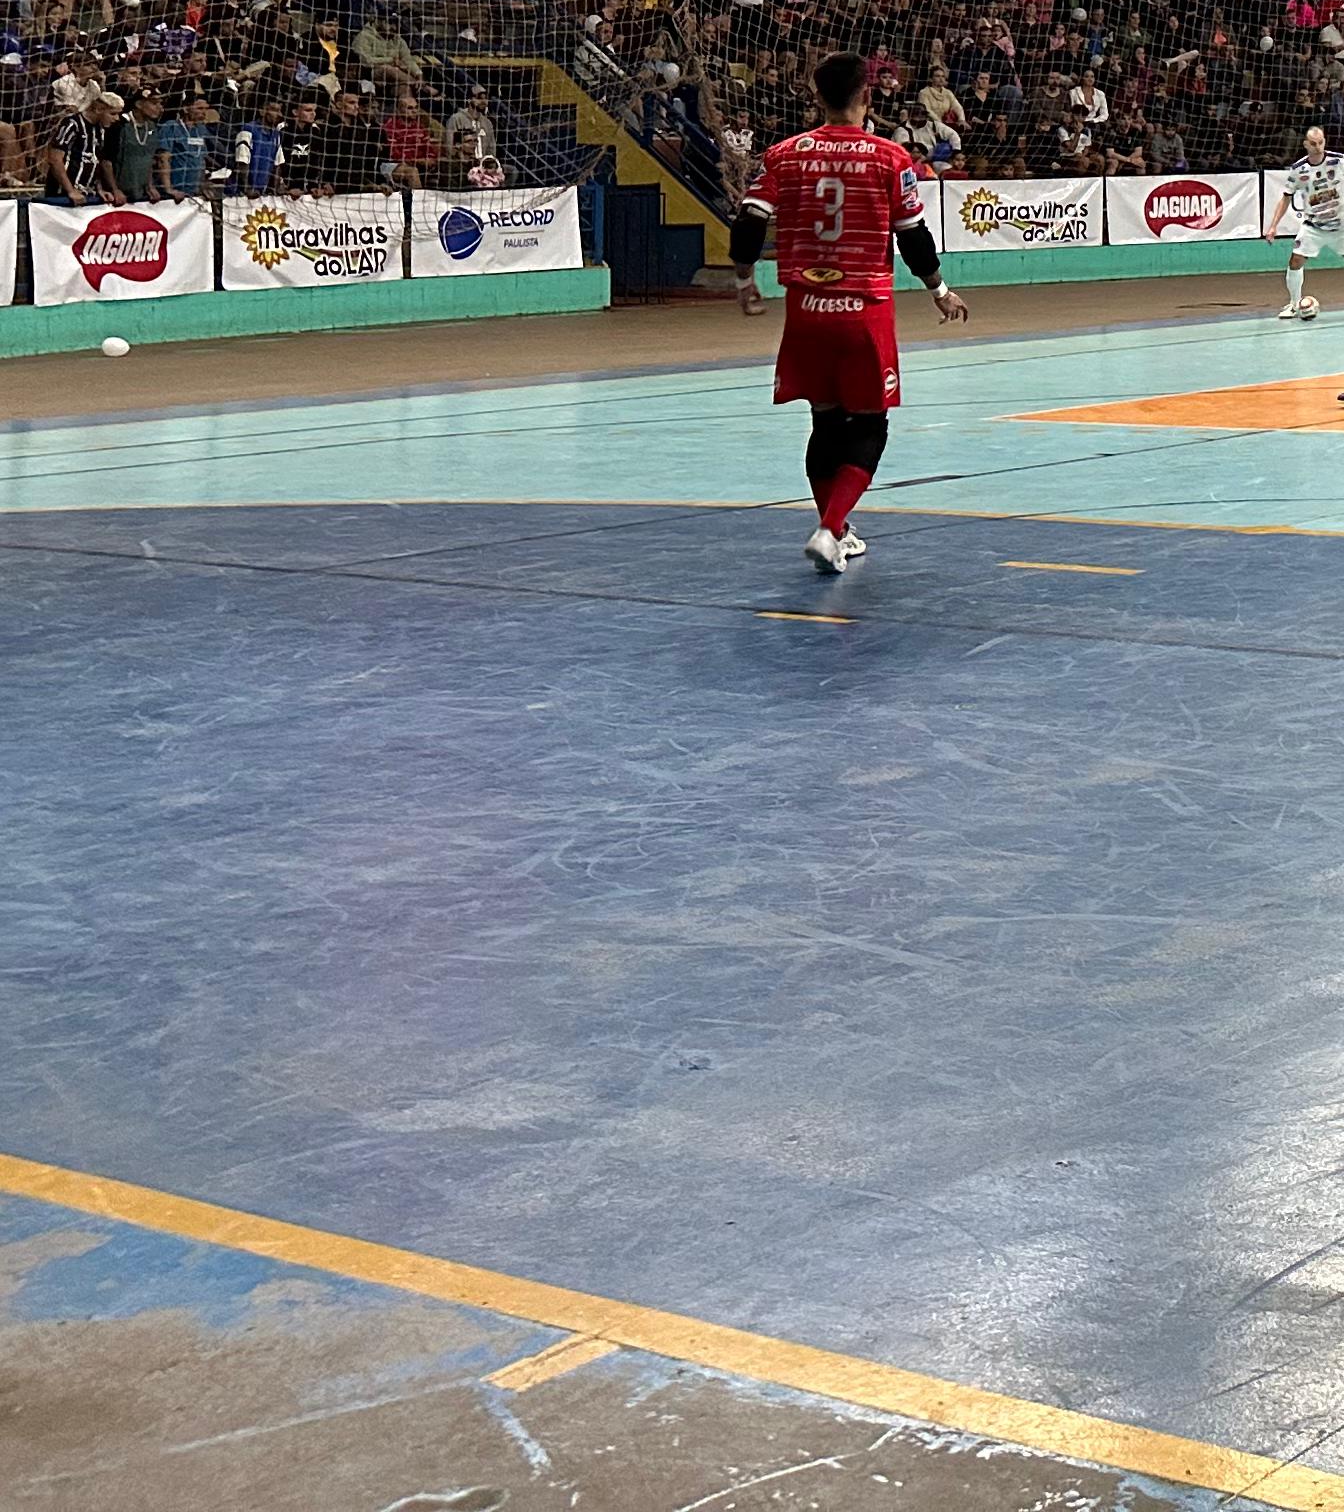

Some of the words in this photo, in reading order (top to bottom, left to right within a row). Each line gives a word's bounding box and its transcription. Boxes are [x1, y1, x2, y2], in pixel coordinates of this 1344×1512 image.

[815, 139, 877, 154] conexão
[814, 176, 845, 242] 3
[1148, 194, 1218, 218] JAGUARI
[487, 208, 555, 228] RECORD
[1022, 226, 1046, 242] do
[1049, 219, 1088, 241] LAR
[79, 230, 164, 265] JAGUARI
[503, 237, 539, 249] PAULISTA
[313, 255, 341, 276] do
[345, 247, 387, 275] LAR
